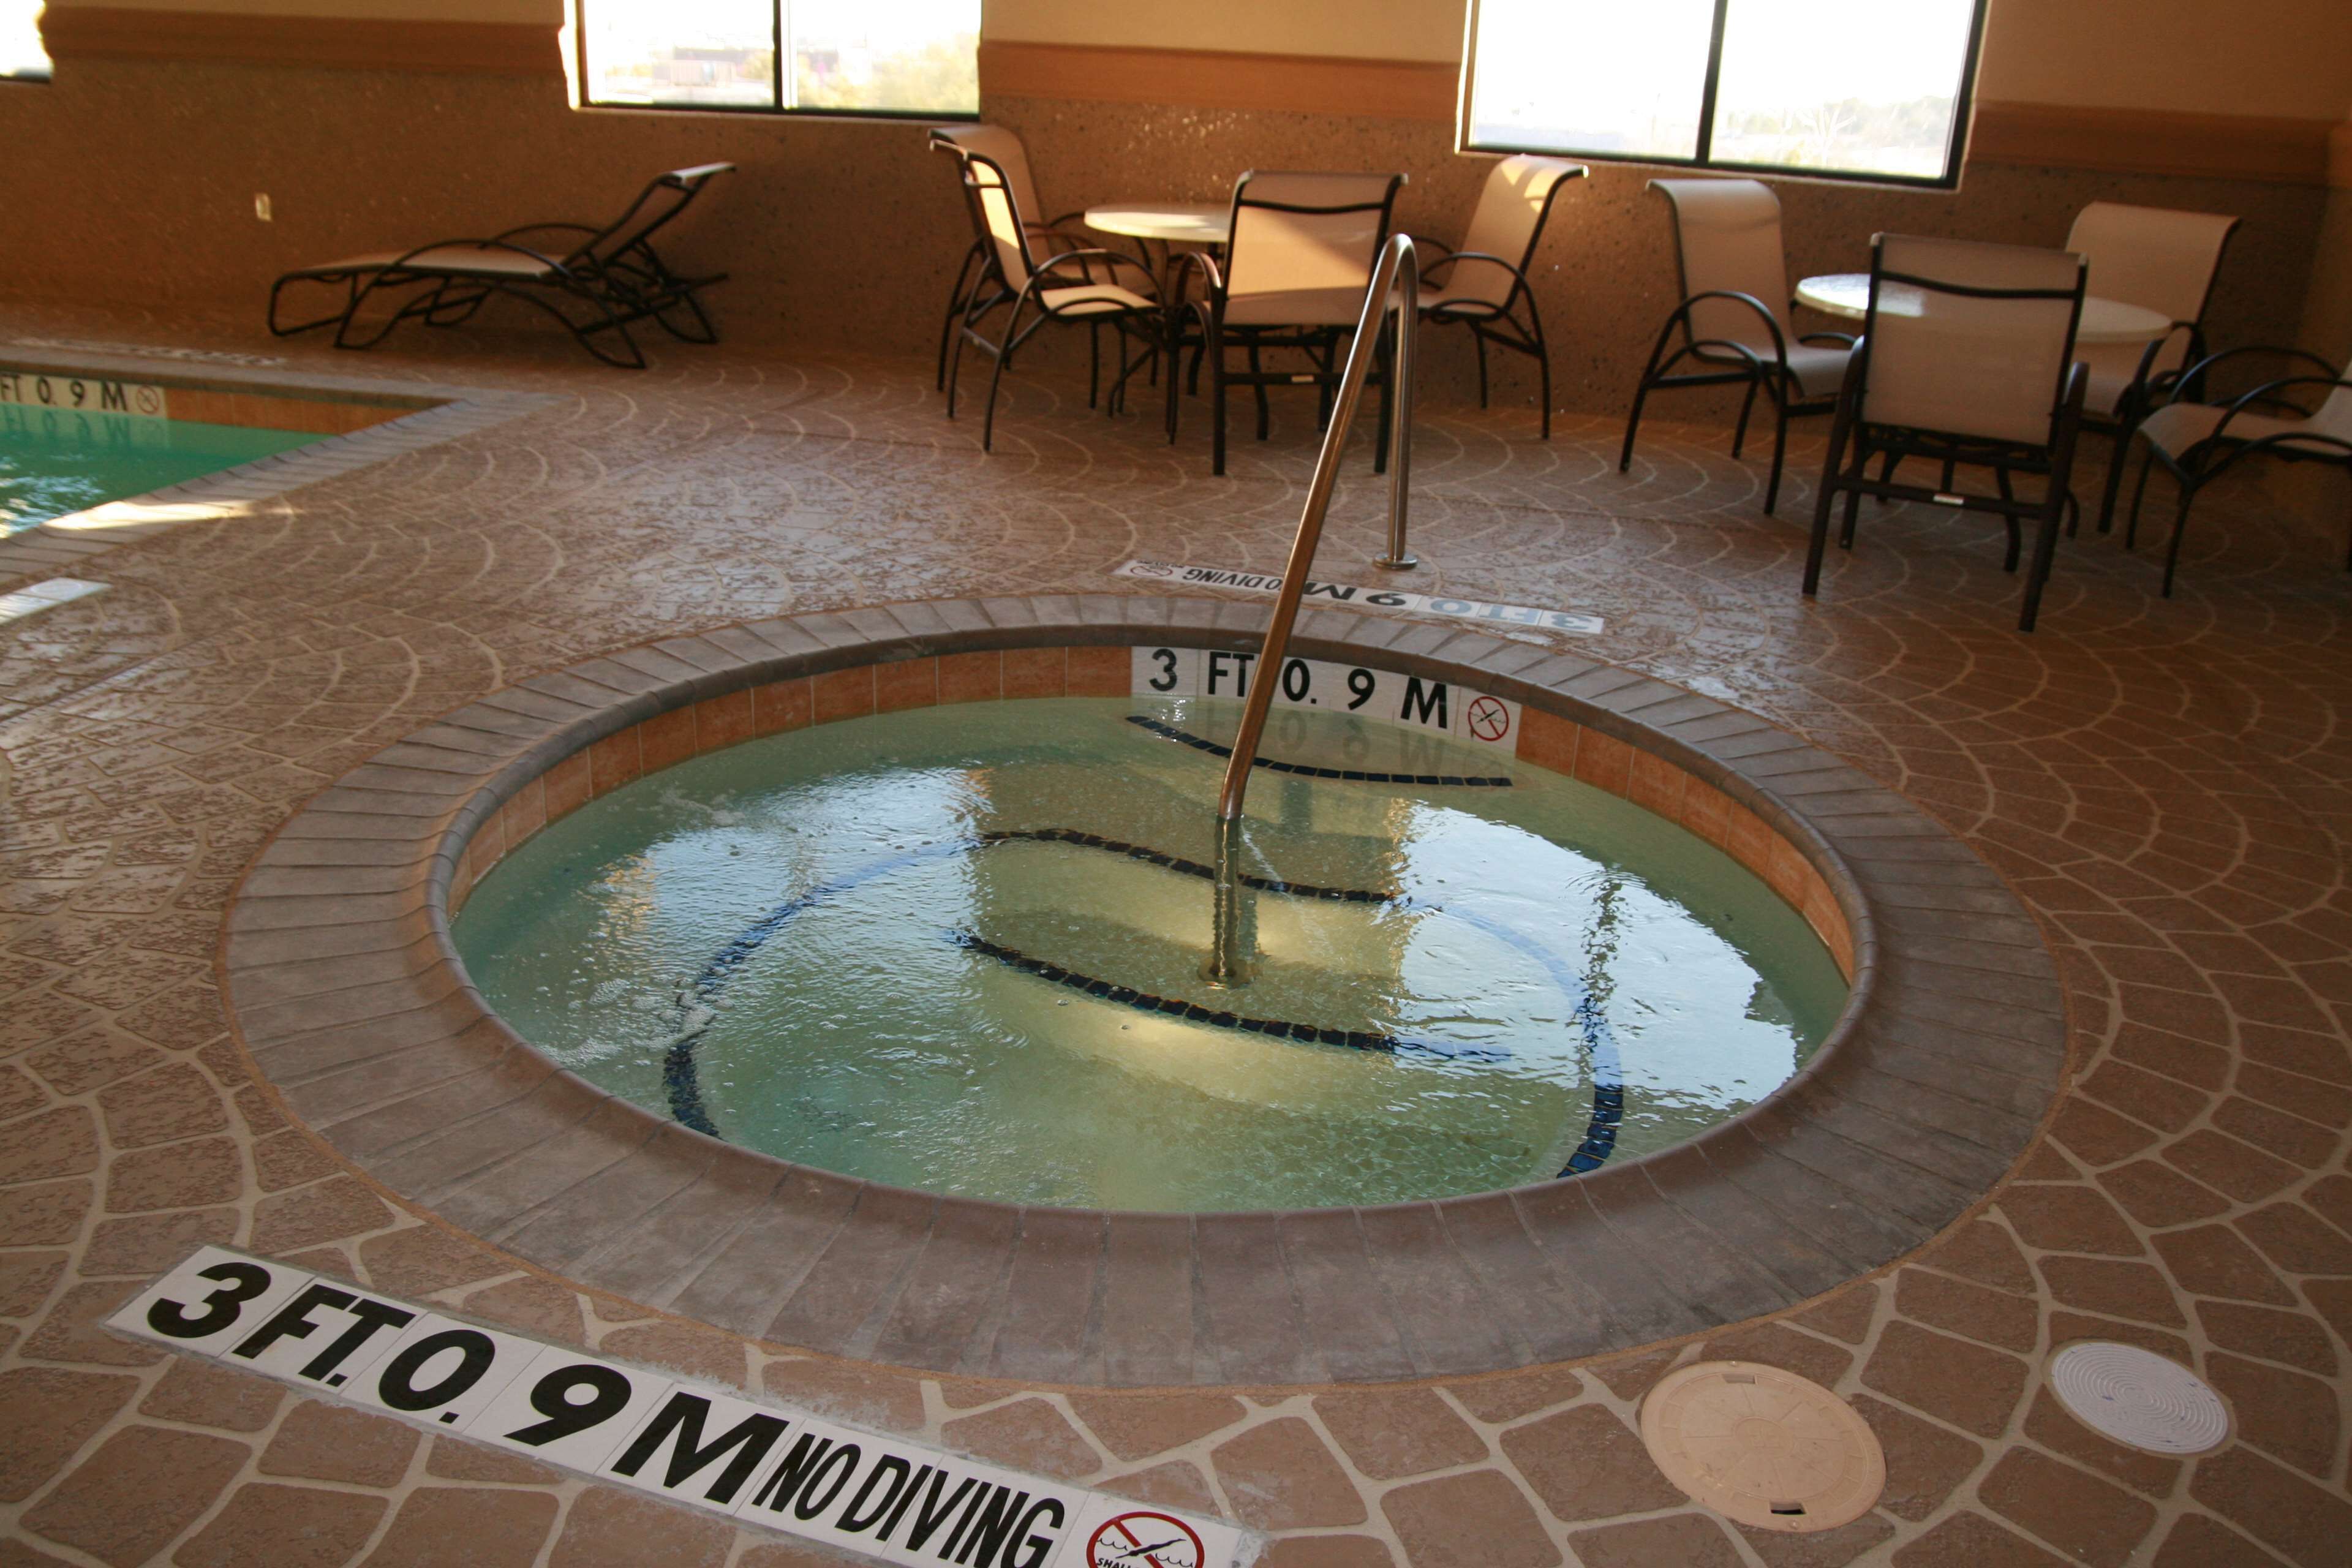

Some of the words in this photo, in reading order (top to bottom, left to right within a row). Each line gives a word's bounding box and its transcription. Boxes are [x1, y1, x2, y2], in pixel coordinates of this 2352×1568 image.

[101, 381, 127, 412] M
[1183, 568, 1261, 588] DIVING
[1303, 582, 1357, 600] M
[1552, 612, 1591, 629] 3
[1149, 648, 1177, 692] 3
[1208, 651, 1254, 697] FT
[1348, 668, 1375, 710] 9
[1400, 677, 1447, 729] M
[146, 1262, 271, 1338] 3
[502, 1364, 632, 1447] 9
[610, 1391, 790, 1504] M
[751, 1433, 861, 1520] NO
[834, 1453, 1065, 1568] DIVING
